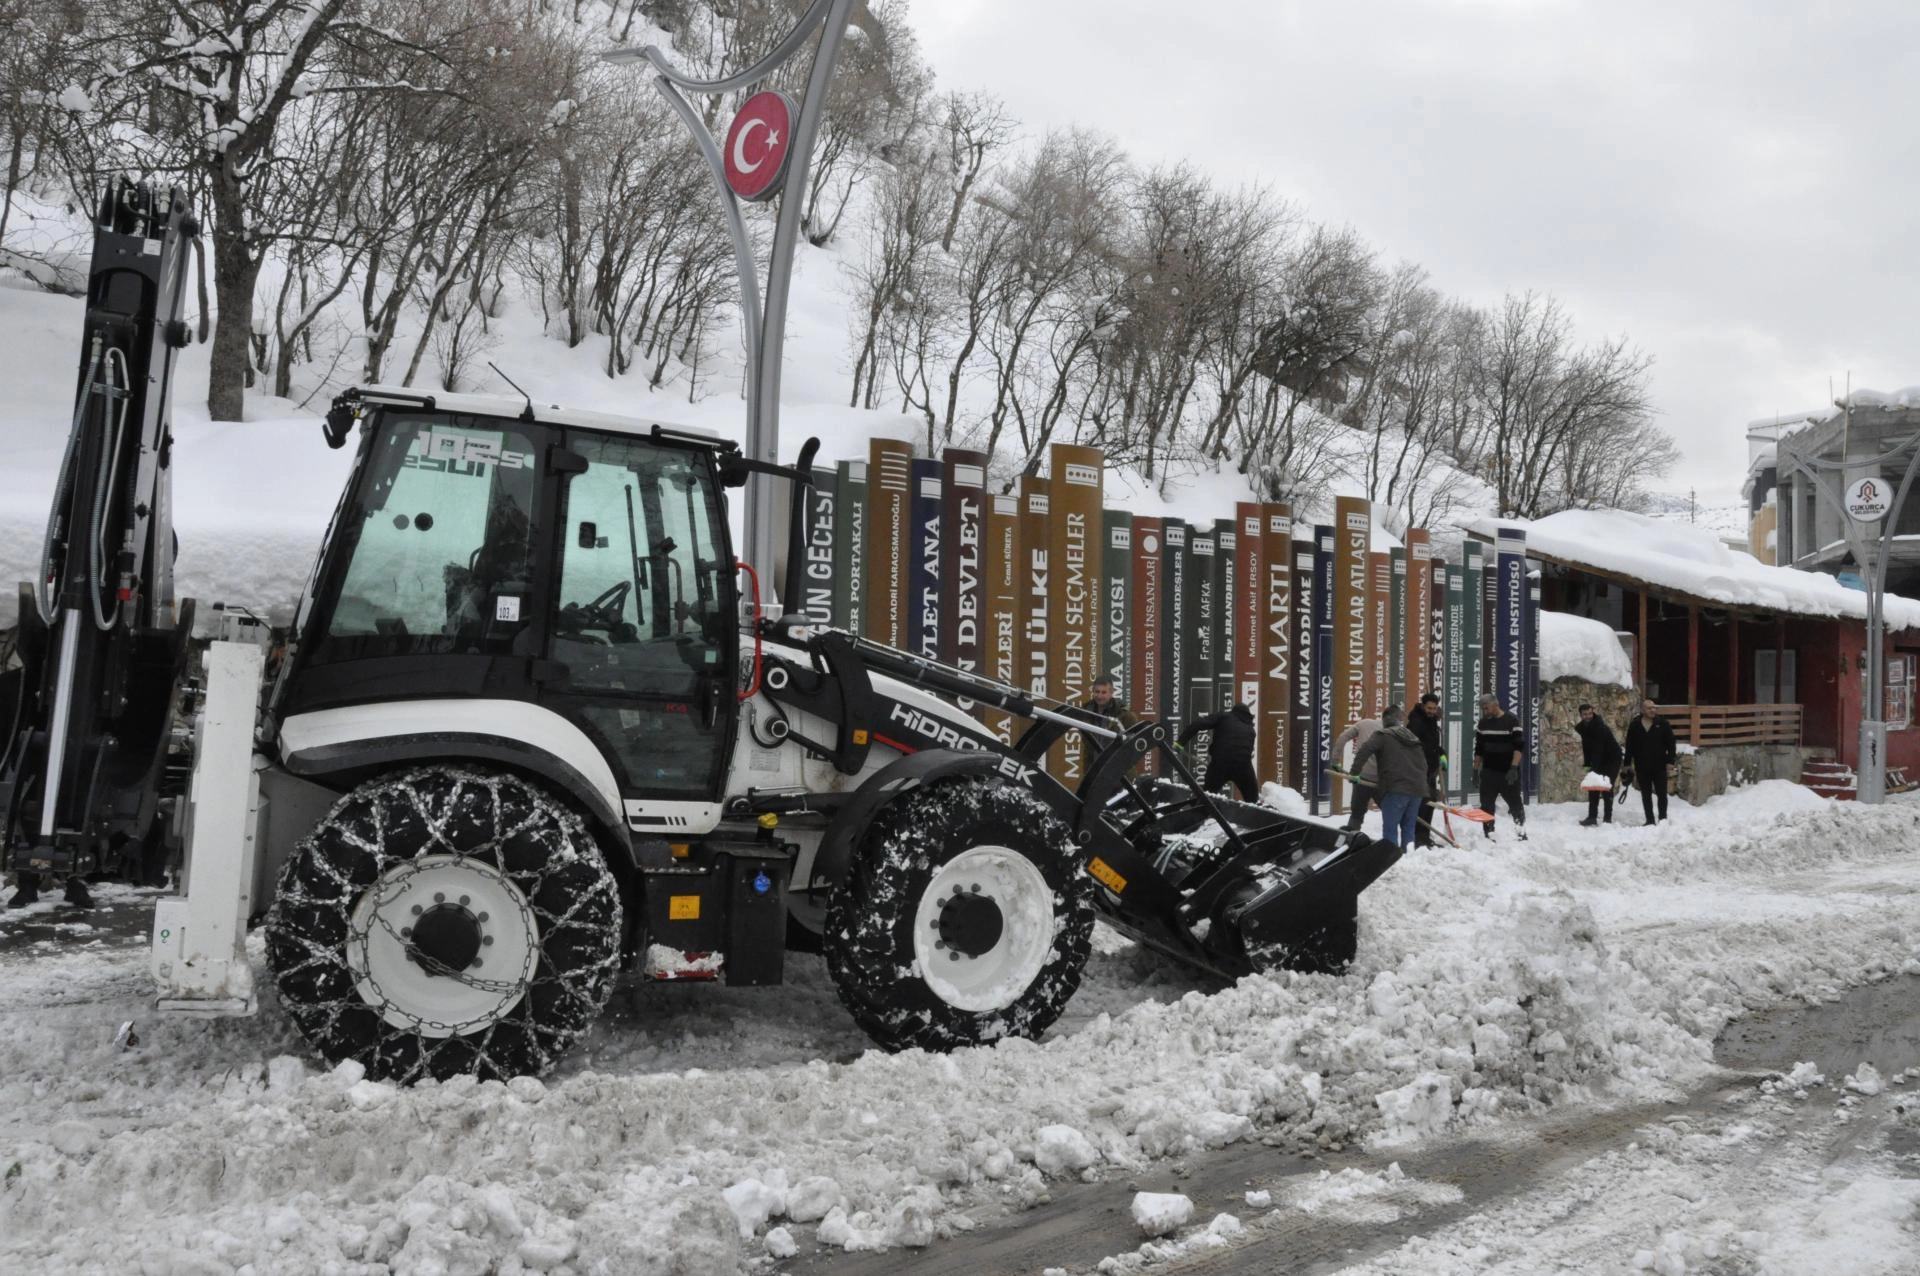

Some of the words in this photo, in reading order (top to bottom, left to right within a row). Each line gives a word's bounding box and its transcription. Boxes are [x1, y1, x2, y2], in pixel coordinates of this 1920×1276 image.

[850, 501, 863, 603] PORTAKALI
[890, 493, 901, 589] KARAOSMANOĞLU
[923, 515, 941, 580] ANA
[957, 497, 980, 646] DEVLET
[1066, 512, 1088, 626] SEÇMELER
[1249, 550, 1258, 588] ERSOY
[1350, 531, 1367, 592] ATLASI
[888, 588, 899, 622] KADRİ
[1026, 548, 1049, 643] ÜLKE
[1110, 576, 1125, 657] AVCISI
[1144, 558, 1157, 629] İNSANLAR
[1200, 581, 1211, 619] KAFKA
[1224, 557, 1234, 637] BRANDBURY
[1249, 590, 1258, 613] Akif
[1268, 563, 1290, 681] MARTI
[1398, 578, 1406, 616] DÜNYA
[1417, 565, 1427, 651] MADONNA
[1507, 560, 1521, 636] ENSTİTÜSÜ
[888, 622, 899, 648] akup
[1145, 628, 1156, 649] VE
[1248, 613, 1257, 658] Mehmet
[1297, 575, 1313, 707] MUKADDİME
[1349, 595, 1366, 666] KITALAR
[1375, 599, 1386, 656] MEVSİM
[1398, 643, 1406, 679] CESUR
[1448, 604, 1460, 673] CEPHESİNDE
[1030, 650, 1047, 700] BU
[1144, 651, 1155, 712] FARELER
[1172, 633, 1182, 714] KARAMAZOV
[1374, 660, 1385, 684] BİR
[1450, 676, 1459, 704] BATI
[1507, 639, 1520, 716] AYARLAMA
[889, 703, 1039, 788] HİDROEK
[1276, 718, 1286, 758] BACH
